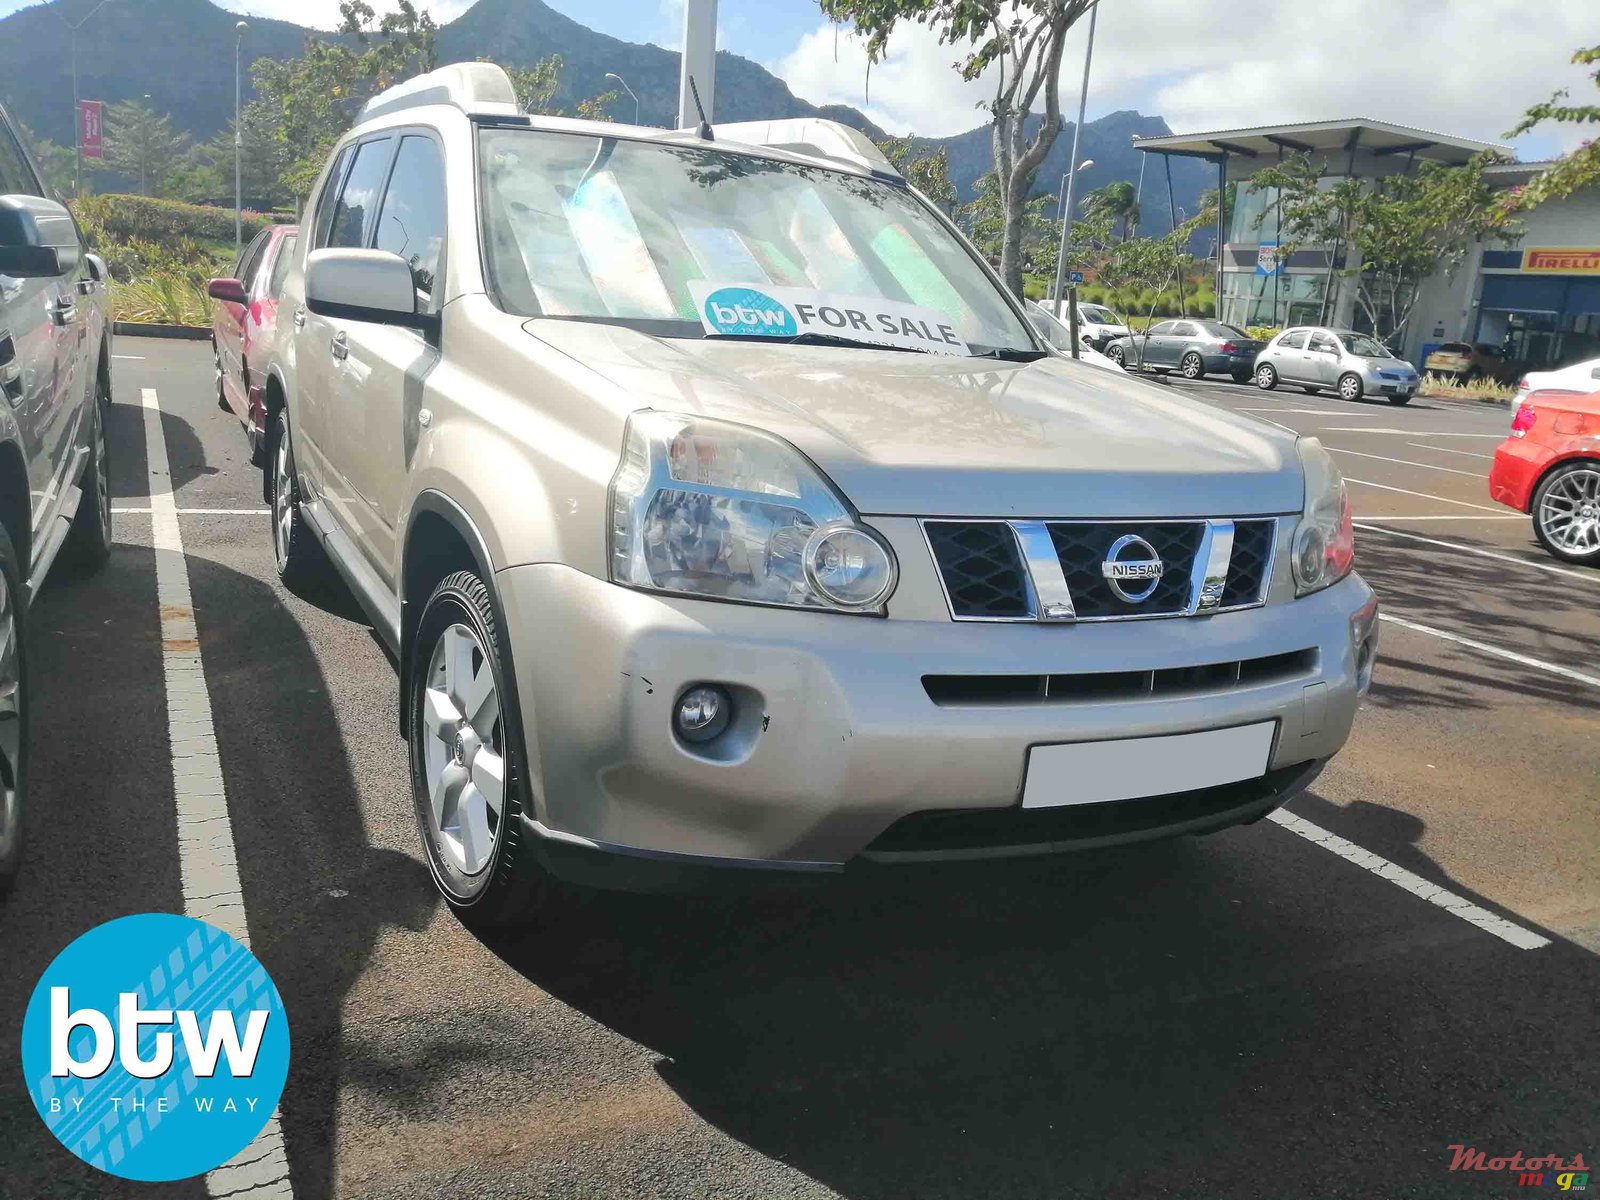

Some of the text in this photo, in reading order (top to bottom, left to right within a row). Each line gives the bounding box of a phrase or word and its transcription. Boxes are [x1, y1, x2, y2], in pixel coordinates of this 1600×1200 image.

[1528, 252, 1600, 269] PIRELLI
[710, 301, 785, 327] btw
[794, 304, 962, 346] FOR SALE
[1112, 564, 1162, 576] NISSAN
